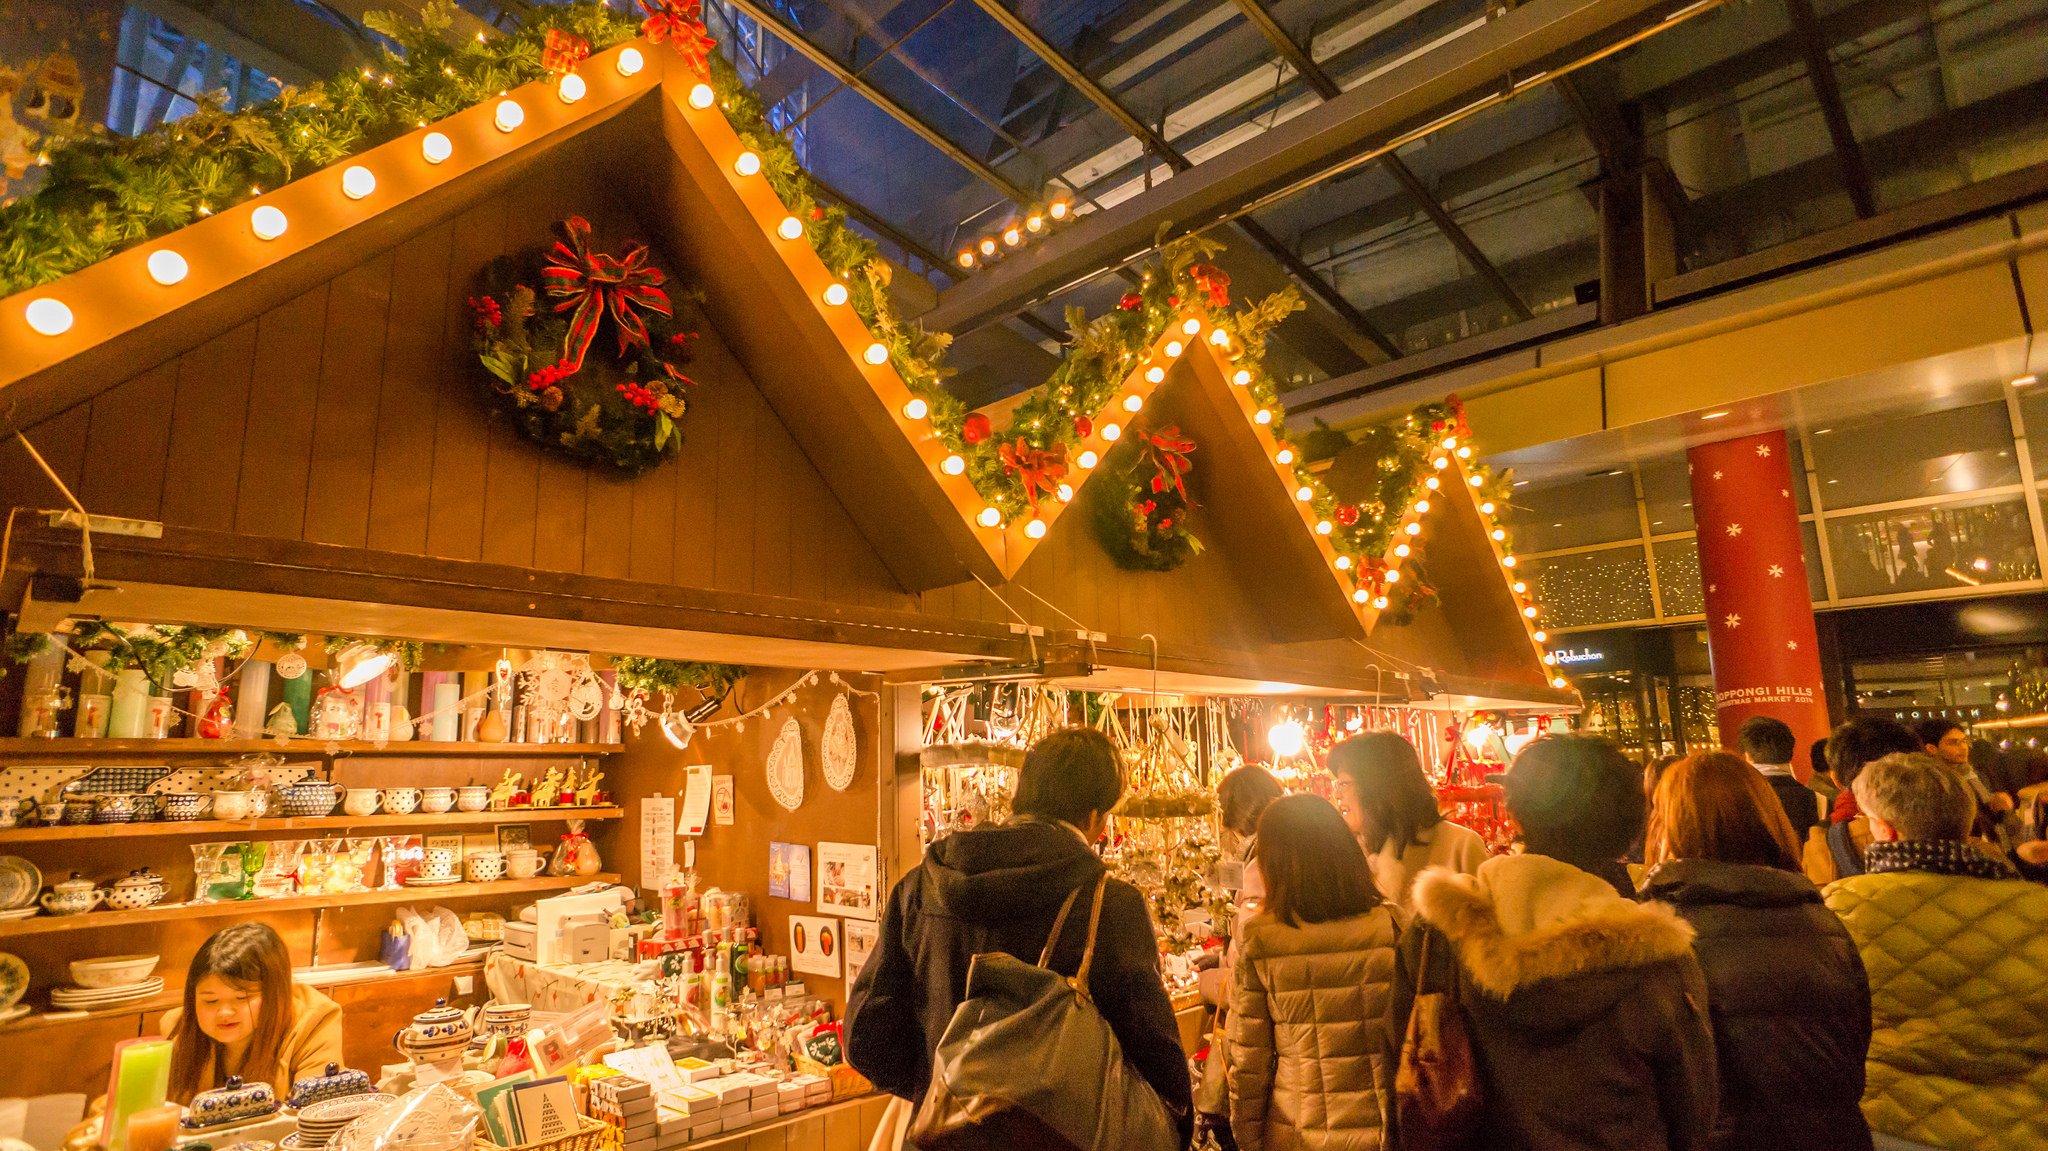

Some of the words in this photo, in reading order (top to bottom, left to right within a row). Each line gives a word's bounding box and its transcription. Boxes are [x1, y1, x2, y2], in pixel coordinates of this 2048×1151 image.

[1555, 648, 1603, 664] Robuchon
[1776, 686, 1812, 697] HILLS
[1754, 696, 1792, 704] MARKET
